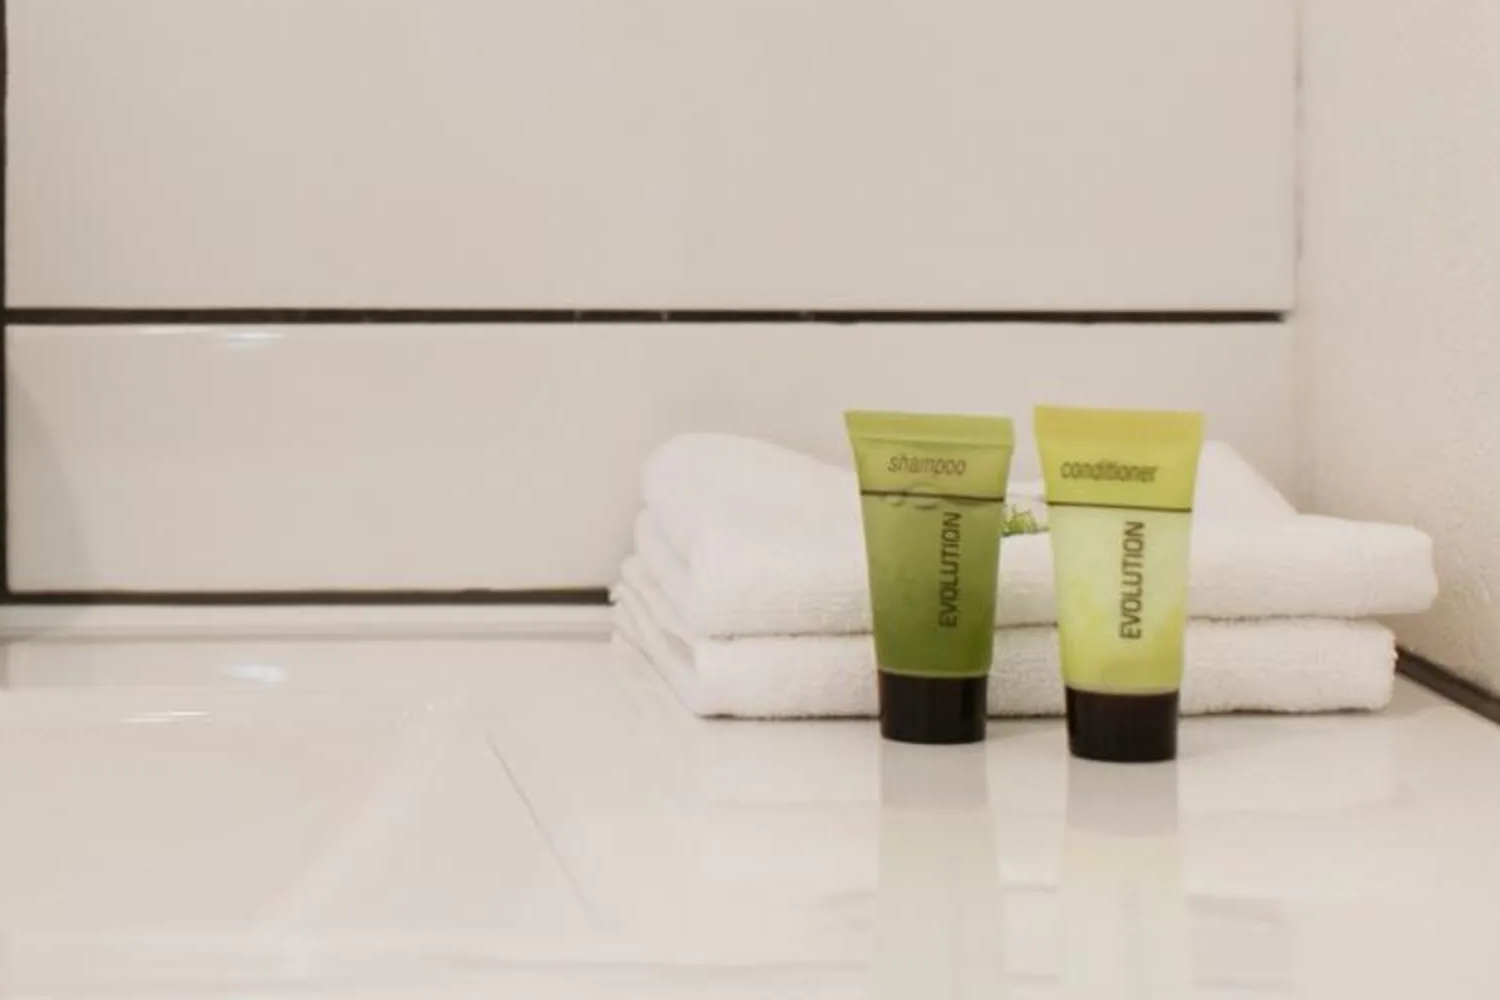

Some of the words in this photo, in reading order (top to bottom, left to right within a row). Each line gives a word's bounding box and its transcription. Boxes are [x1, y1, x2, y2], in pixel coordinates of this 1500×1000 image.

[886, 453, 967, 477] shampoo
[1059, 456, 1159, 484] conditioner
[938, 511, 963, 629] EVOLUTION
[1119, 521, 1146, 640] EVOLUTION
